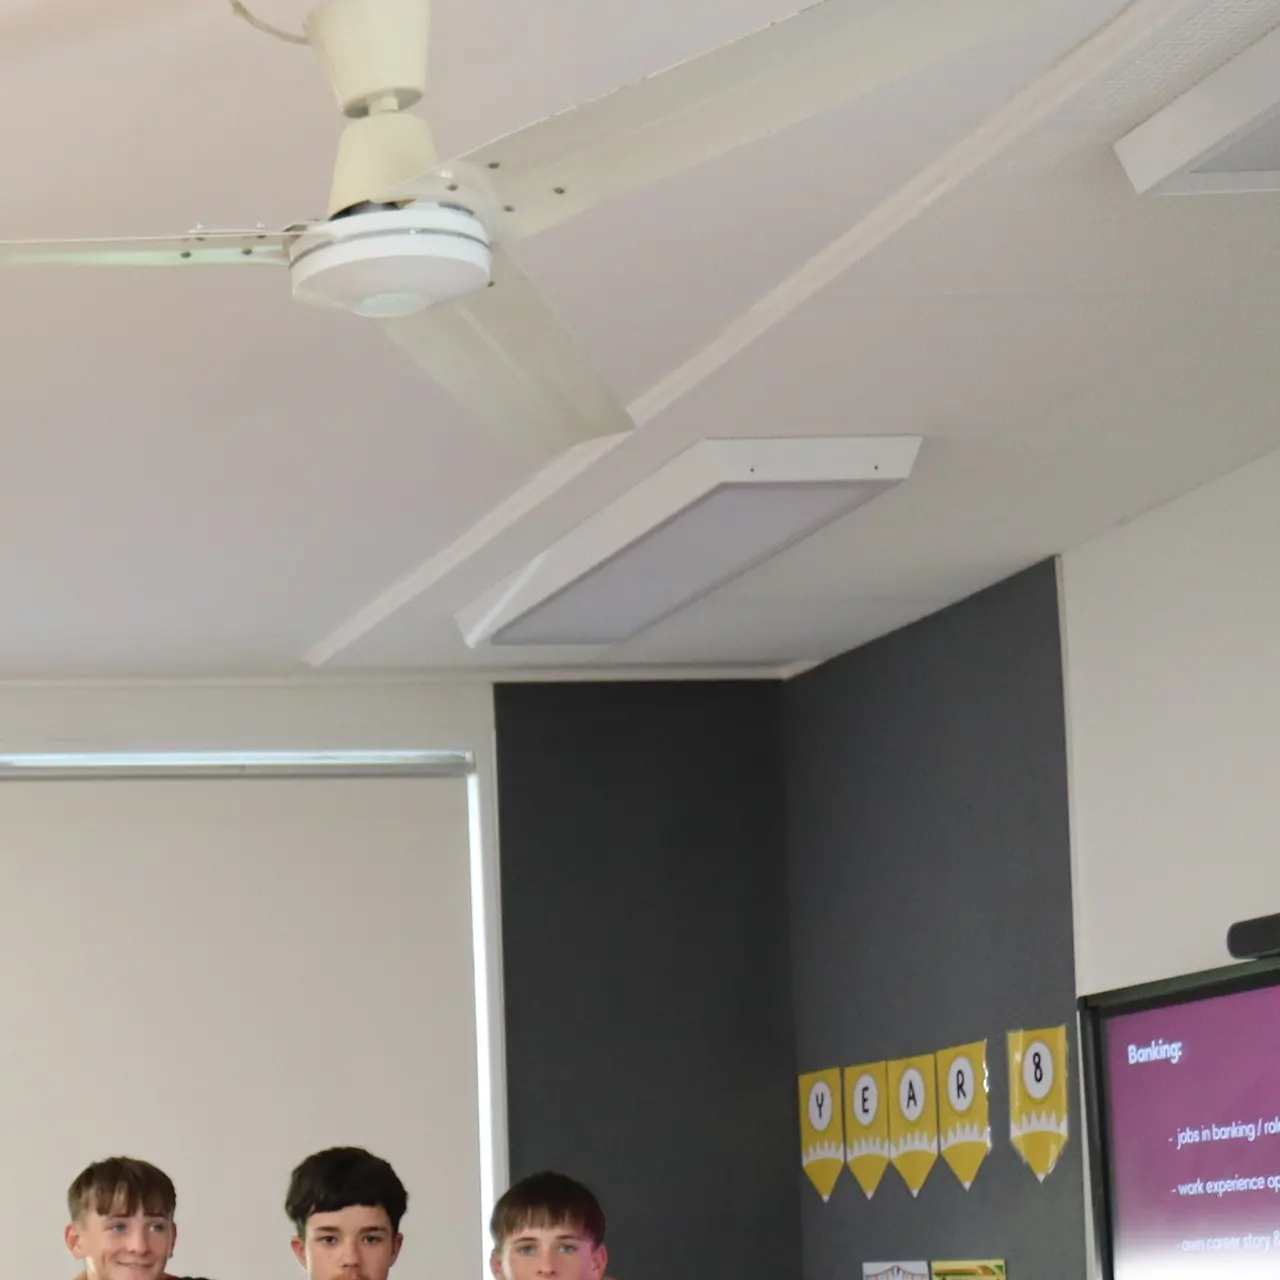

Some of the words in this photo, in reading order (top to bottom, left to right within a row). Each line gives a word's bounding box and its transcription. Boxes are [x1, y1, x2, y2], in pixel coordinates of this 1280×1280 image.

[1127, 1039, 1183, 1065] Banking:
[814, 1069, 967, 1119] YEAR
[1176, 1127, 1201, 1151] jobs
[1201, 1124, 1211, 1142] in
[1212, 1119, 1256, 1143] banking
[1177, 1177, 1205, 1197] work
[1206, 1174, 1266, 1199] experience
